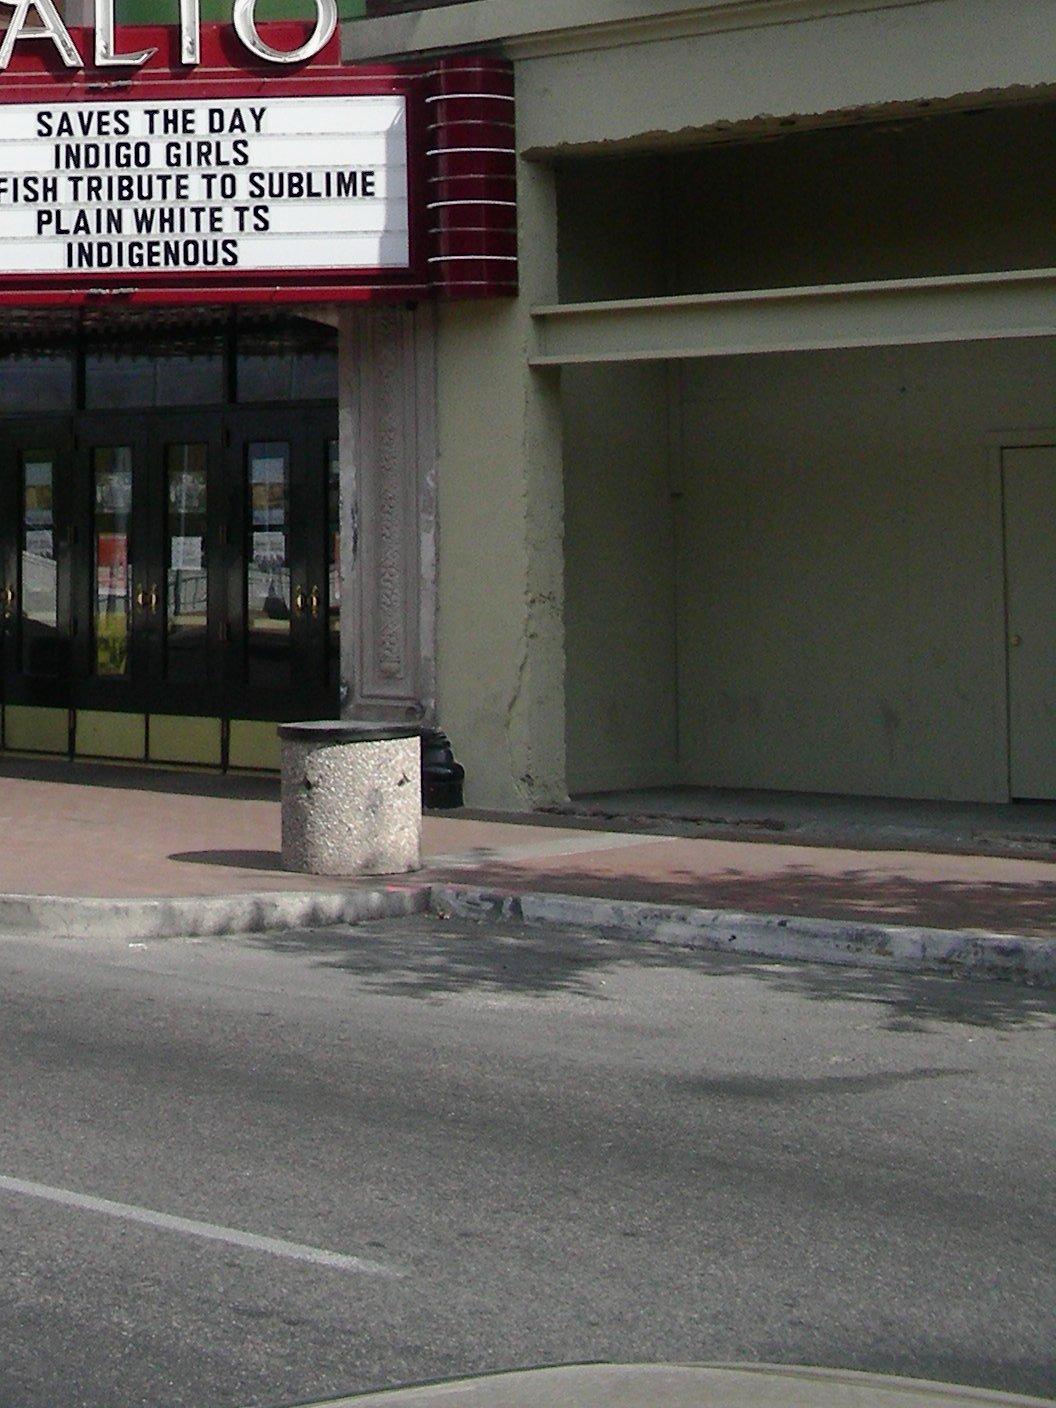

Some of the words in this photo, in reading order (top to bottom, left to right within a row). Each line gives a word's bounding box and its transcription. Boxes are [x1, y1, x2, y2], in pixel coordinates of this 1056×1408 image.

[37, 109, 130, 138] SAVES
[143, 108, 195, 135] THE
[208, 106, 267, 134] DAY
[54, 141, 151, 170] INDIGO
[165, 139, 250, 168] GIRLS
[68, 174, 189, 202] TRIBUTE
[201, 173, 237, 200] TO
[248, 170, 375, 199] SUBLIME
[37, 208, 123, 236] PLAIN
[133, 206, 223, 235] WHITE
[233, 204, 270, 233] TS
[66, 239, 238, 269] INDIGENOUS
